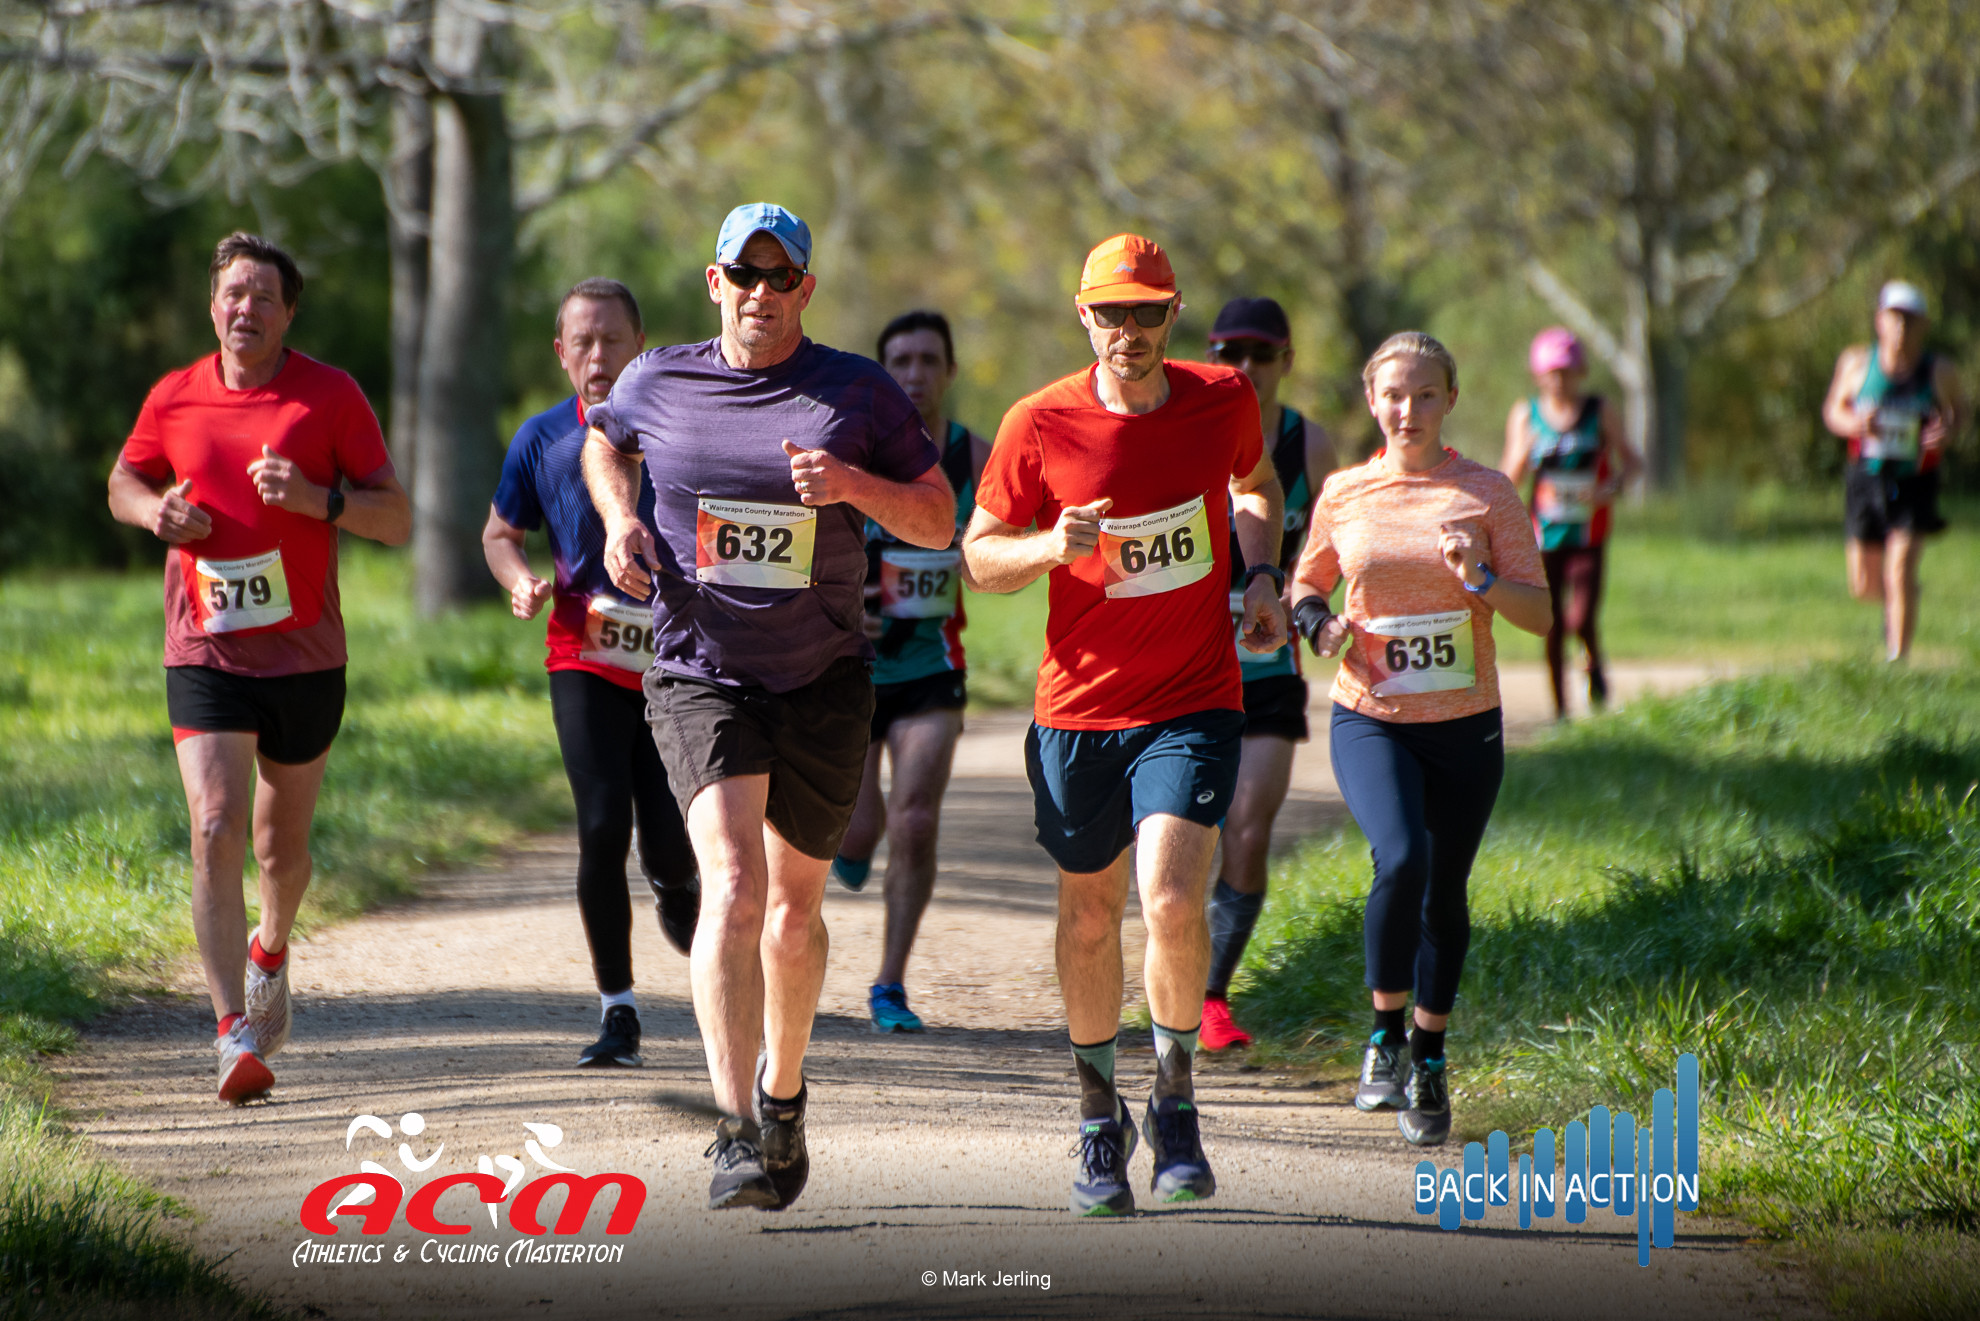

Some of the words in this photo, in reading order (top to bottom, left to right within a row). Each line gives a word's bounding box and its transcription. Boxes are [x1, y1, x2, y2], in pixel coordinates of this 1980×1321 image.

[709, 504, 743, 513] Wairarapa
[745, 508, 772, 516] Country
[1142, 516, 1169, 527] Country
[1170, 505, 1198, 519] Marathon
[717, 524, 793, 563] 632
[1120, 526, 1195, 574] 646
[210, 575, 272, 612] 579
[897, 570, 949, 599] 562
[1406, 619, 1432, 628] Country
[1386, 634, 1456, 673] 635
